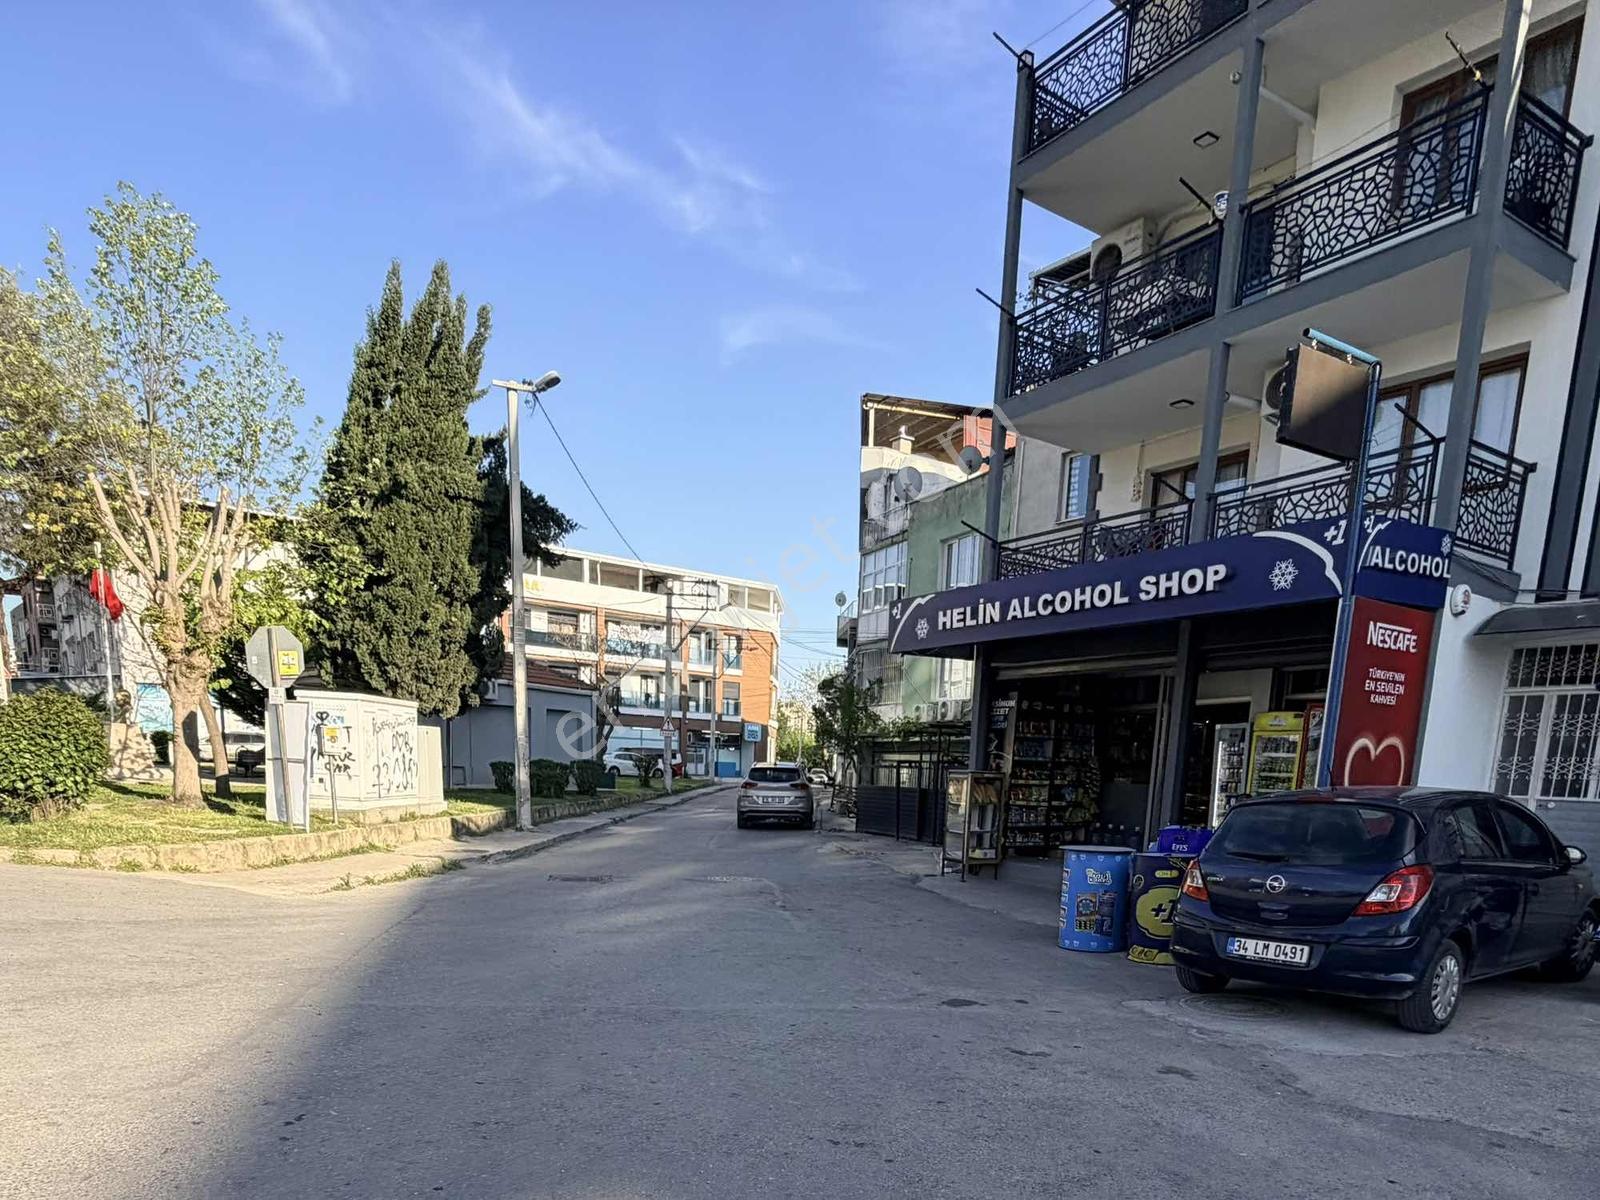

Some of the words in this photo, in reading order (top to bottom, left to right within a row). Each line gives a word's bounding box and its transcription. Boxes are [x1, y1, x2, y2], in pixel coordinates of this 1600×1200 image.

[1323, 519, 1348, 546] +1
[1369, 545, 1451, 578] ALCOHOL
[937, 597, 1000, 631] HELİN
[1006, 580, 1129, 621] ALCOHOL
[1138, 563, 1227, 602] SHOP
[1364, 680, 1376, 691] EN
[1234, 939, 1248, 953] 34
[1253, 942, 1270, 957] LM
[1274, 944, 1305, 961] 0491
